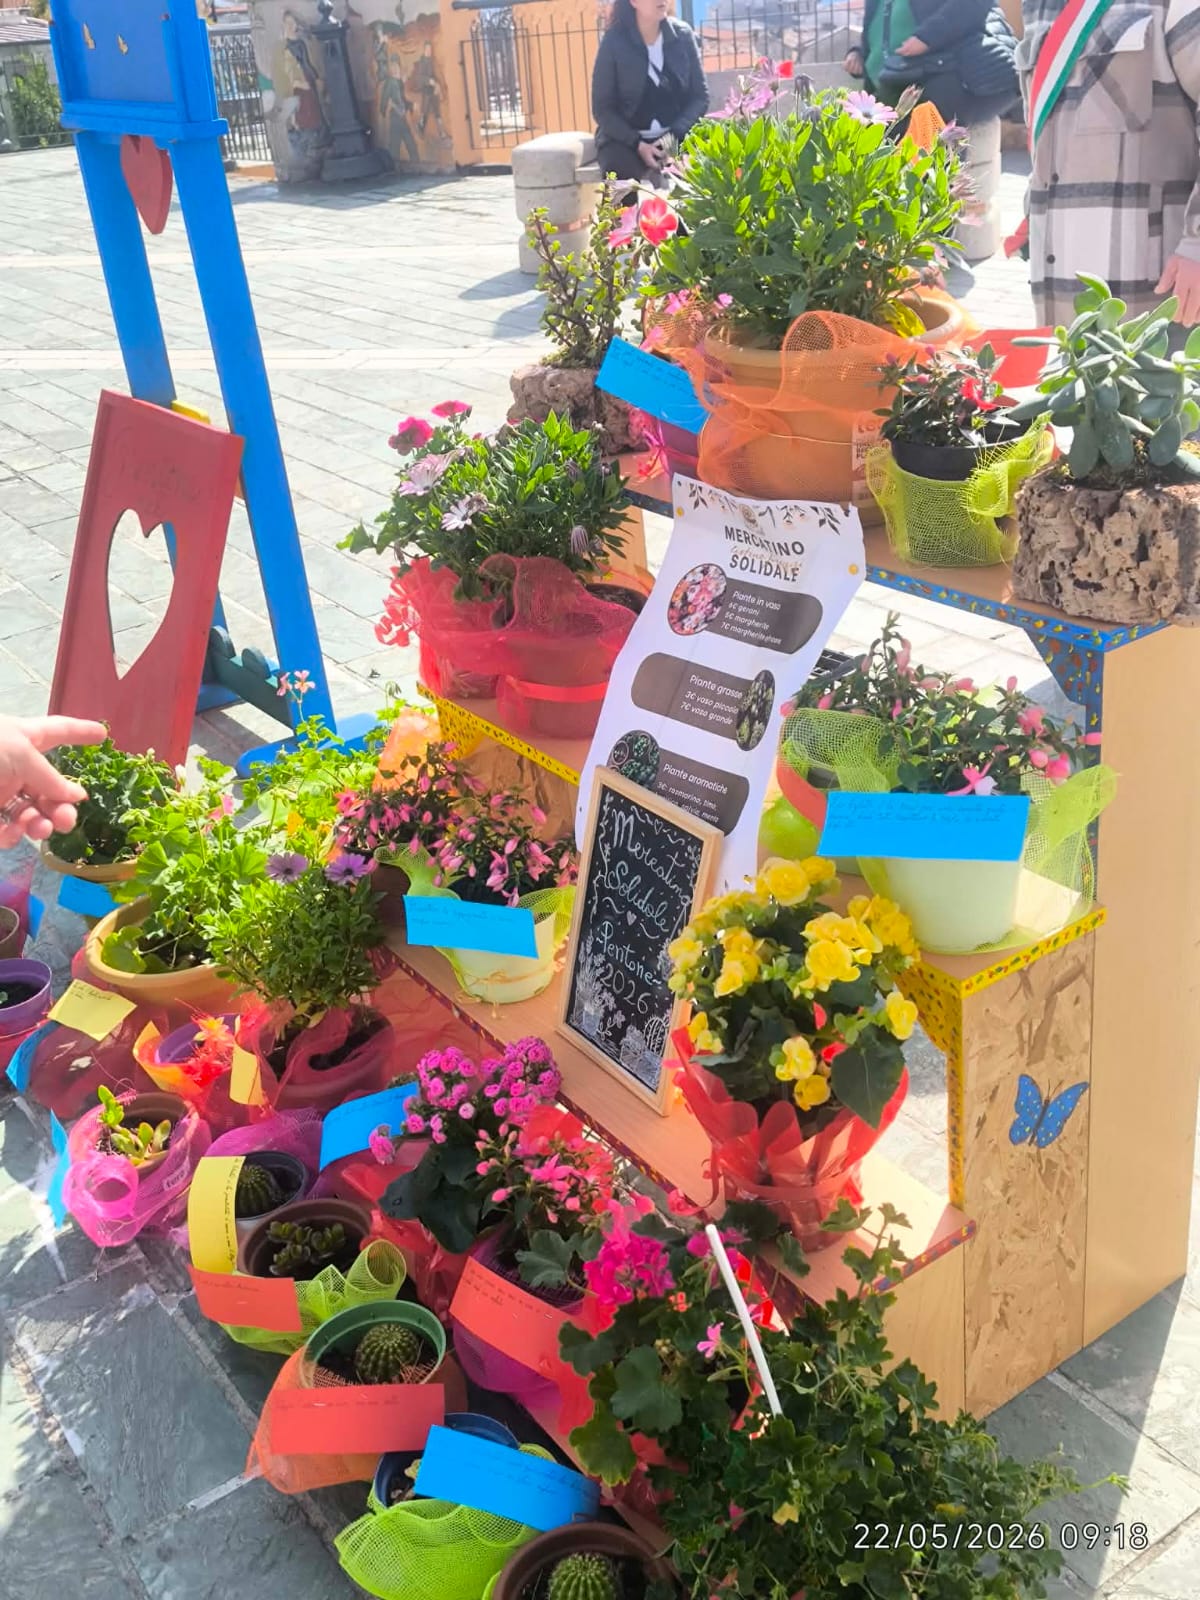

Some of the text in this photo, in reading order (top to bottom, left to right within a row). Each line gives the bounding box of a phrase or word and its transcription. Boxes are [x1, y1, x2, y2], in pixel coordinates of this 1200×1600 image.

[725, 525, 804, 556] MERCATINO
[729, 554, 799, 582] SOLIDALE
[733, 591, 781, 611] Piante in vaso
[690, 674, 743, 698] Piante grasse
[691, 706, 708, 717] vaso
[708, 712, 733, 725] grande
[696, 695, 714, 706] vaso
[713, 702, 739, 714] piccolo
[663, 763, 728, 795] Piante aromatiche
[612, 809, 693, 906] Mercatino
[605, 861, 669, 932] Solidale
[600, 963, 651, 1014] 2026
